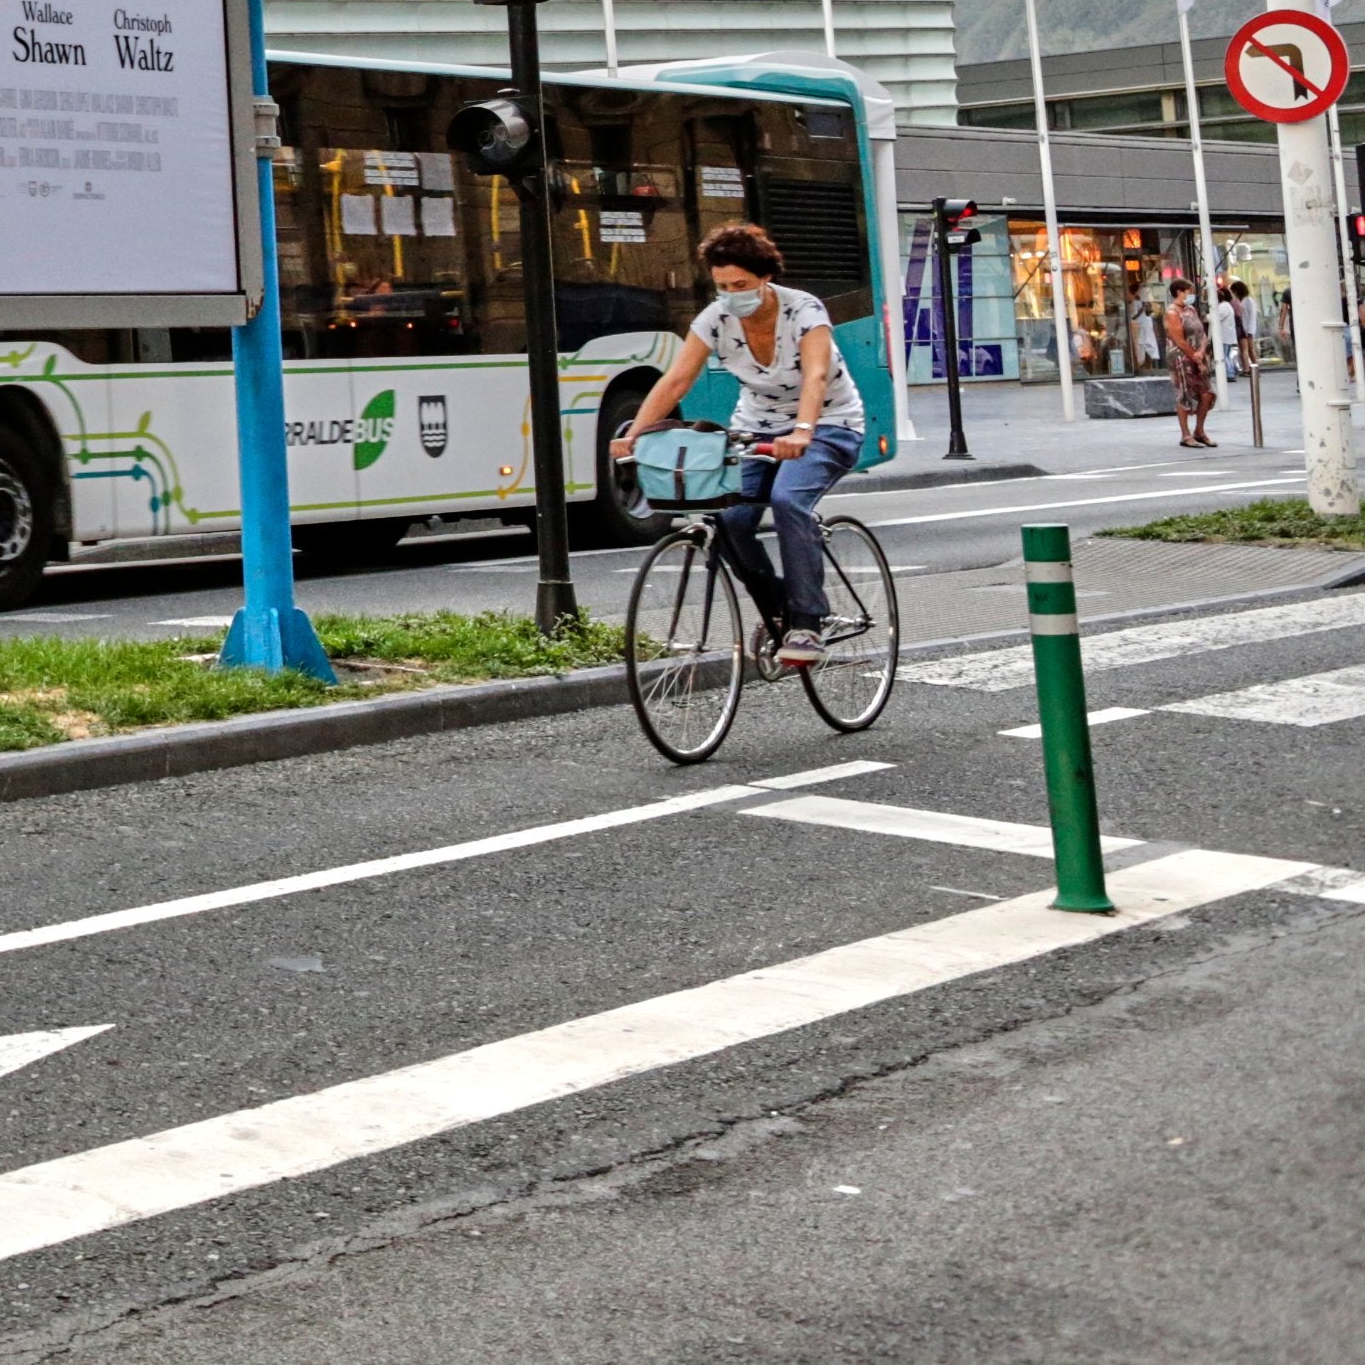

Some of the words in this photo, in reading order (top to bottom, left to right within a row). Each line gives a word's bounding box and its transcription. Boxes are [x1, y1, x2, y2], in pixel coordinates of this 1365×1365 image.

[21, 0, 73, 25] Wallace
[113, 8, 172, 36] Christoph
[12, 26, 87, 66] Shawn
[113, 34, 174, 72] Waltz
